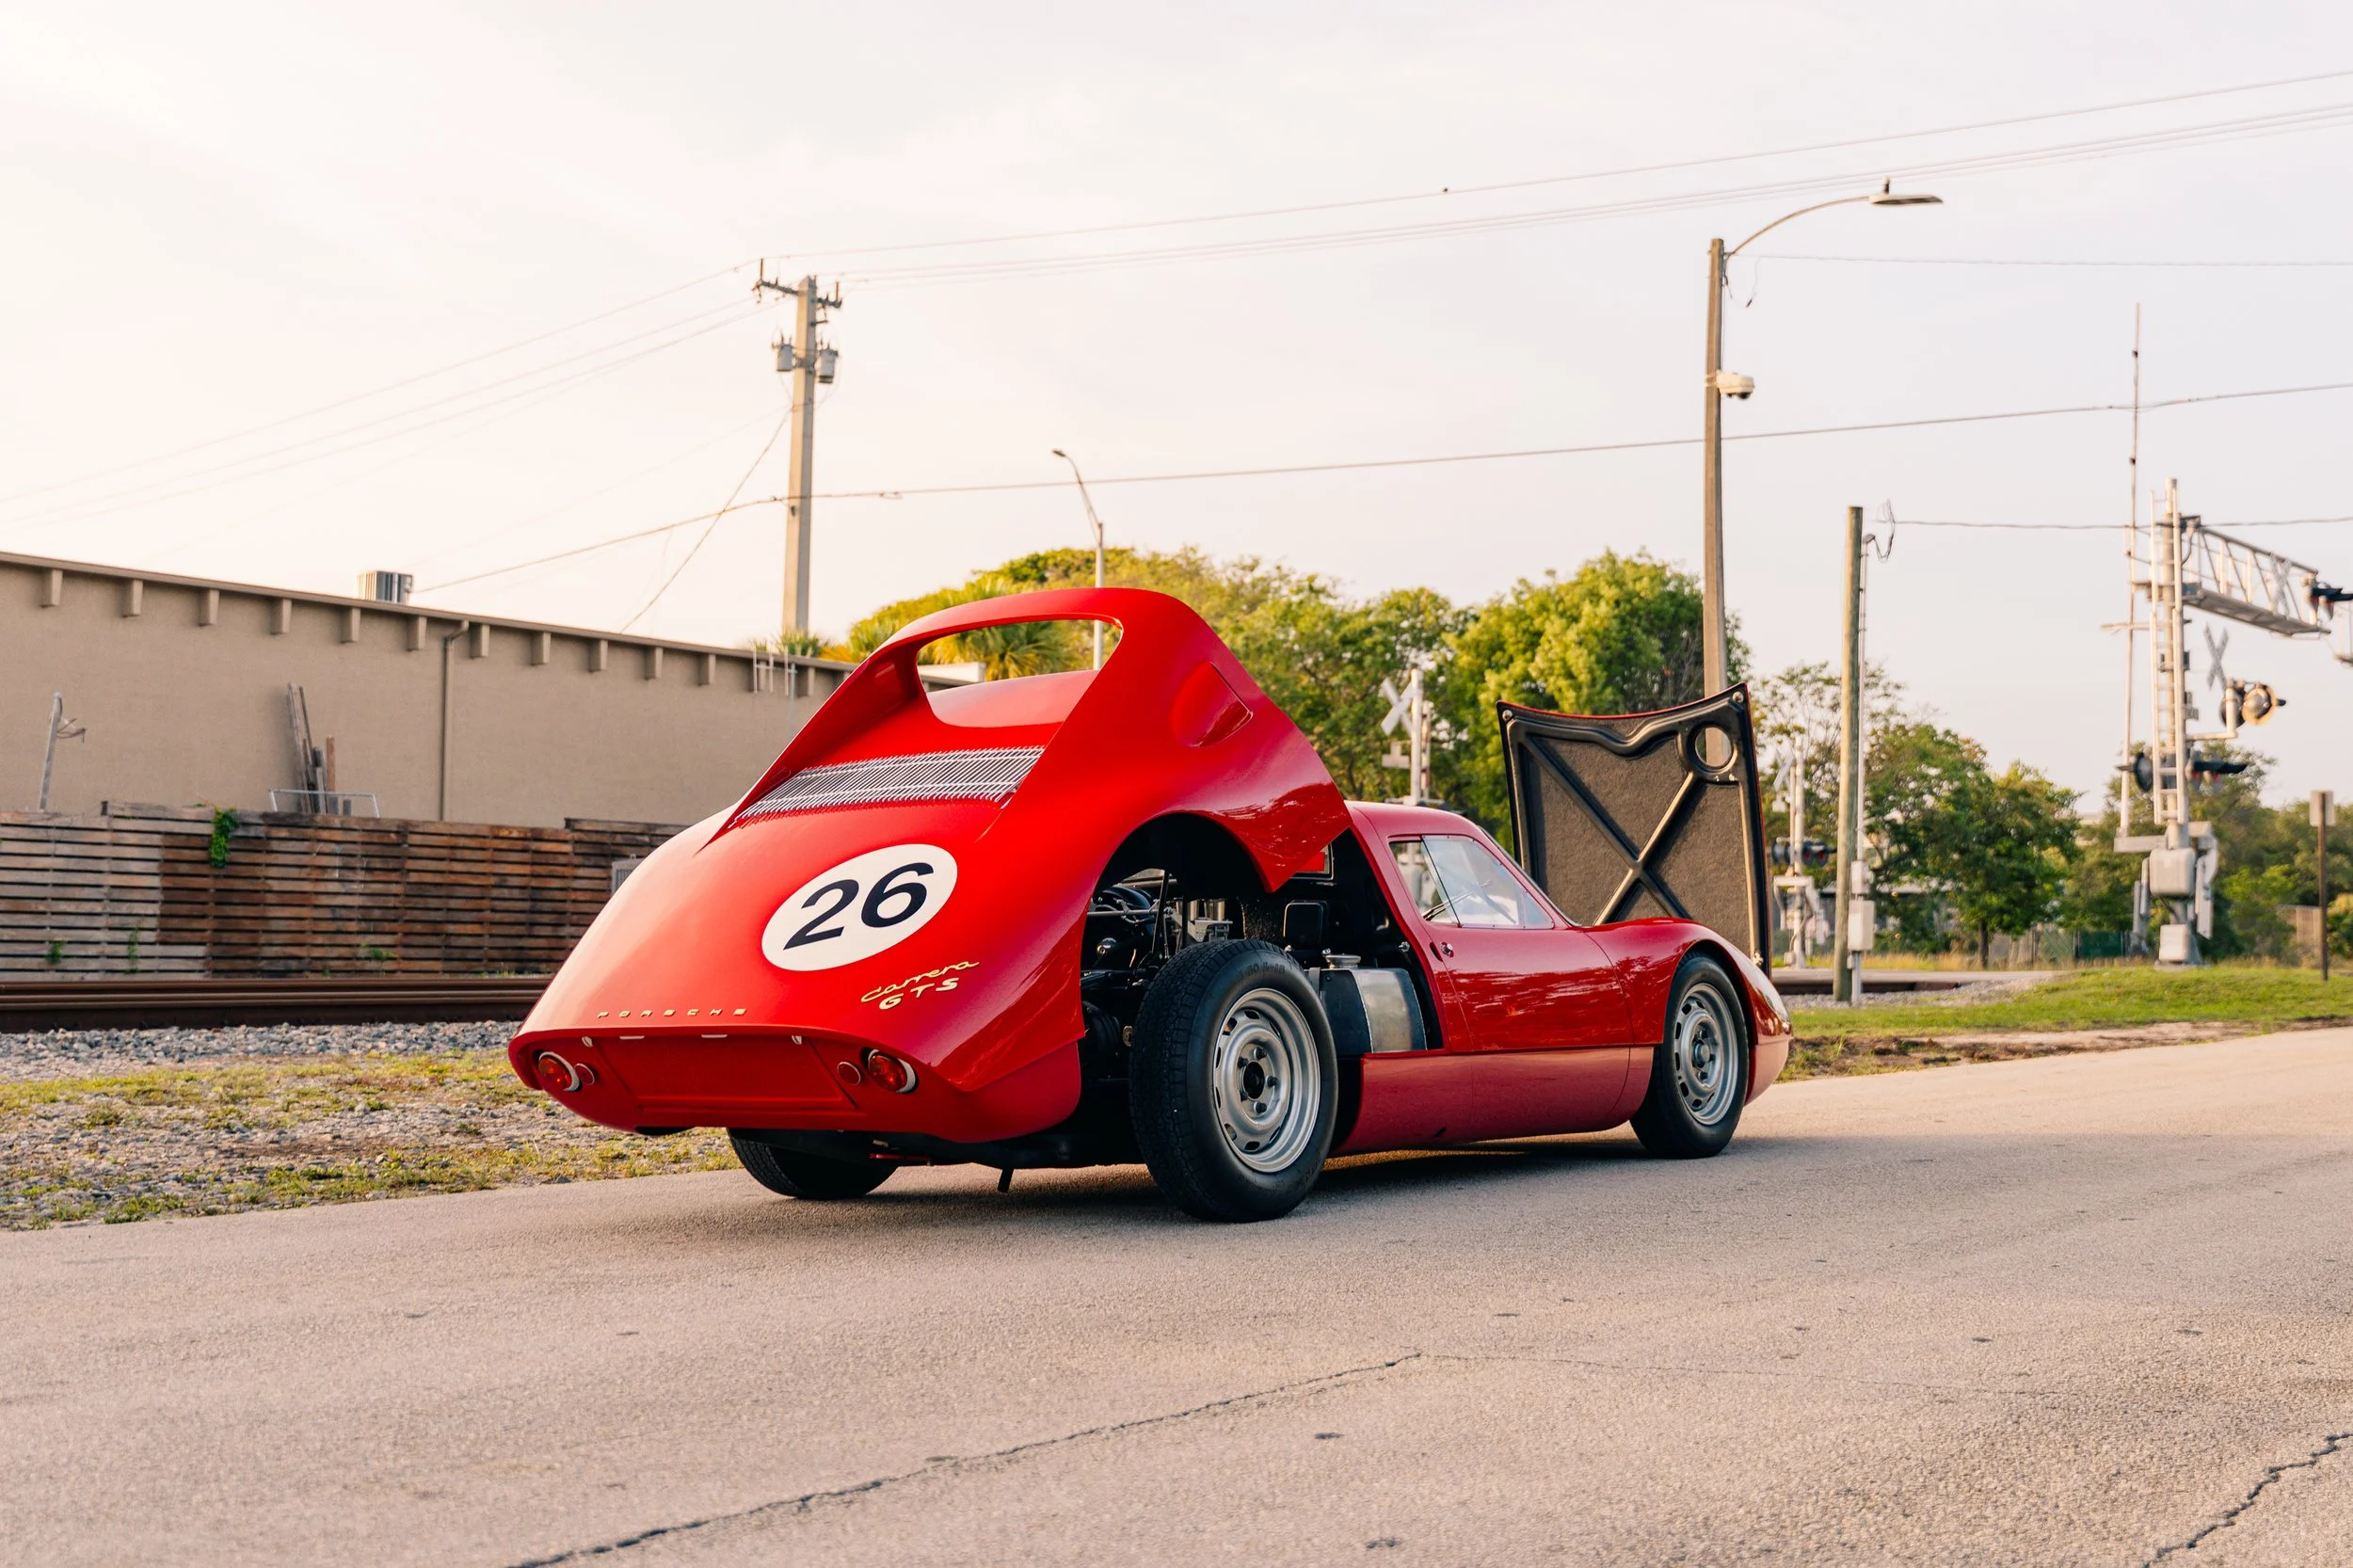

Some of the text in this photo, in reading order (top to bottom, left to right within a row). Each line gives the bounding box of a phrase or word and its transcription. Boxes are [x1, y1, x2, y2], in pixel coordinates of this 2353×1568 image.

[783, 862, 934, 951] 26
[879, 977, 959, 1010] GTS
[597, 1008, 747, 1019] PORSCHE
